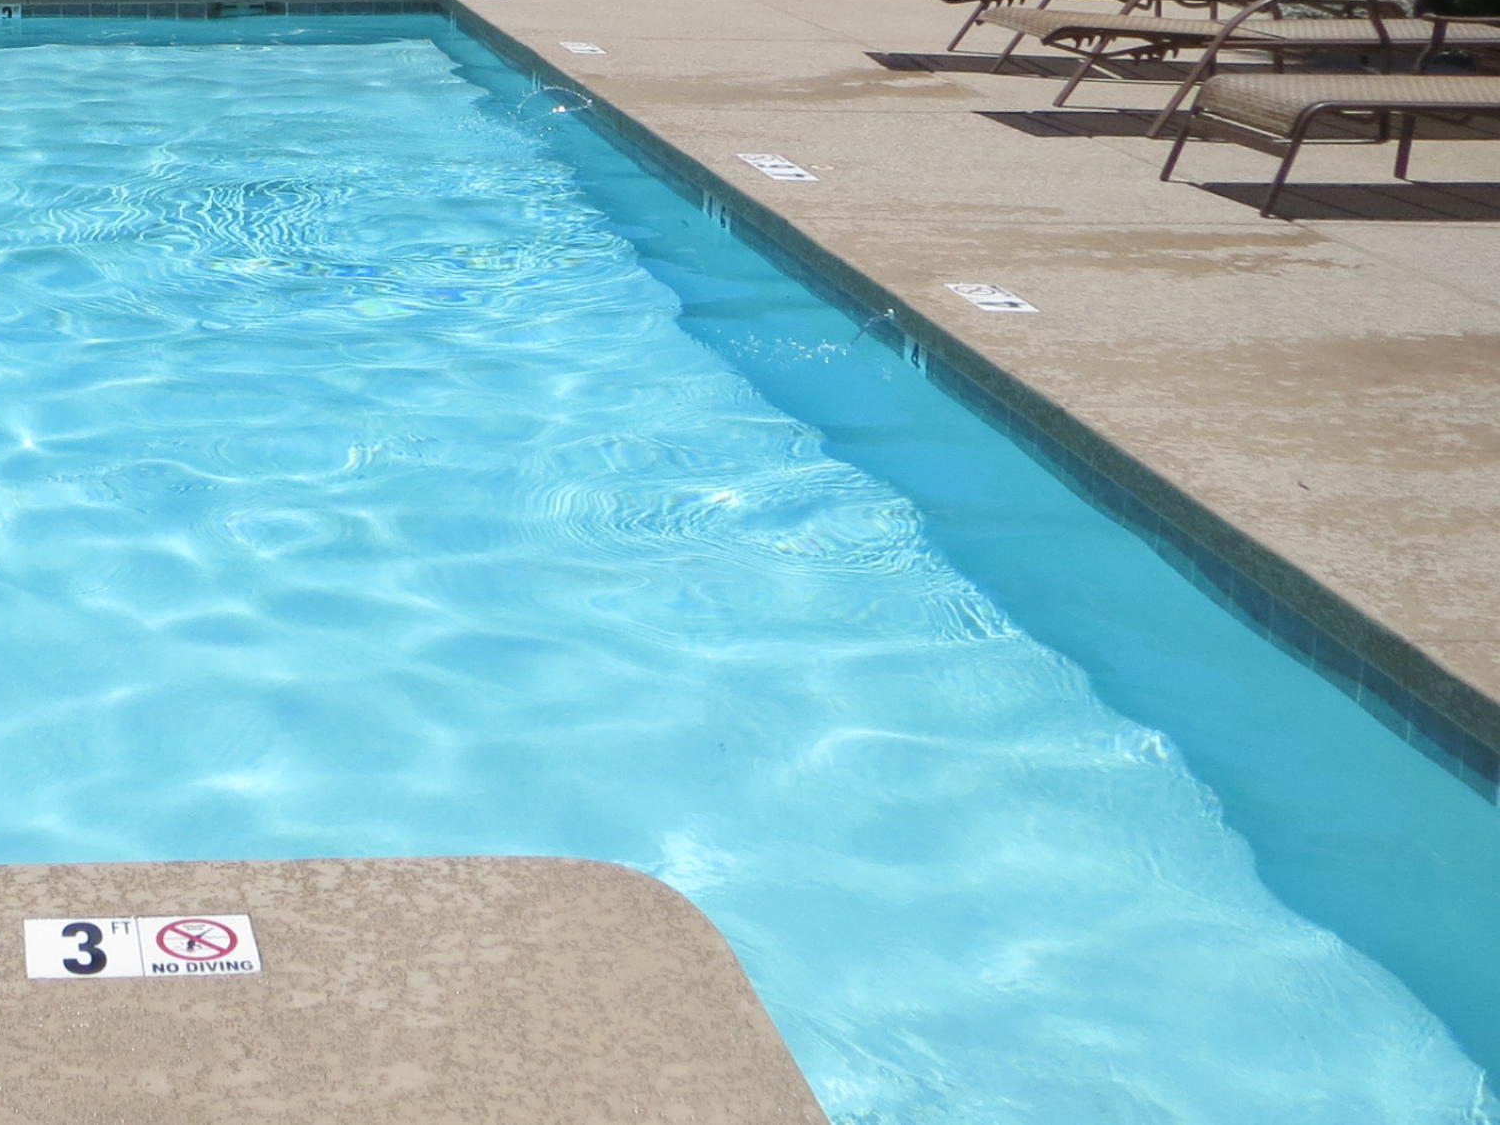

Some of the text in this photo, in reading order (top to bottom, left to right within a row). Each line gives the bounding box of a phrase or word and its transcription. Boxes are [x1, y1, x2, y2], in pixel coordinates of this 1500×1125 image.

[61, 921, 131, 975] 3 FT
[152, 960, 254, 974] NO DIVING
